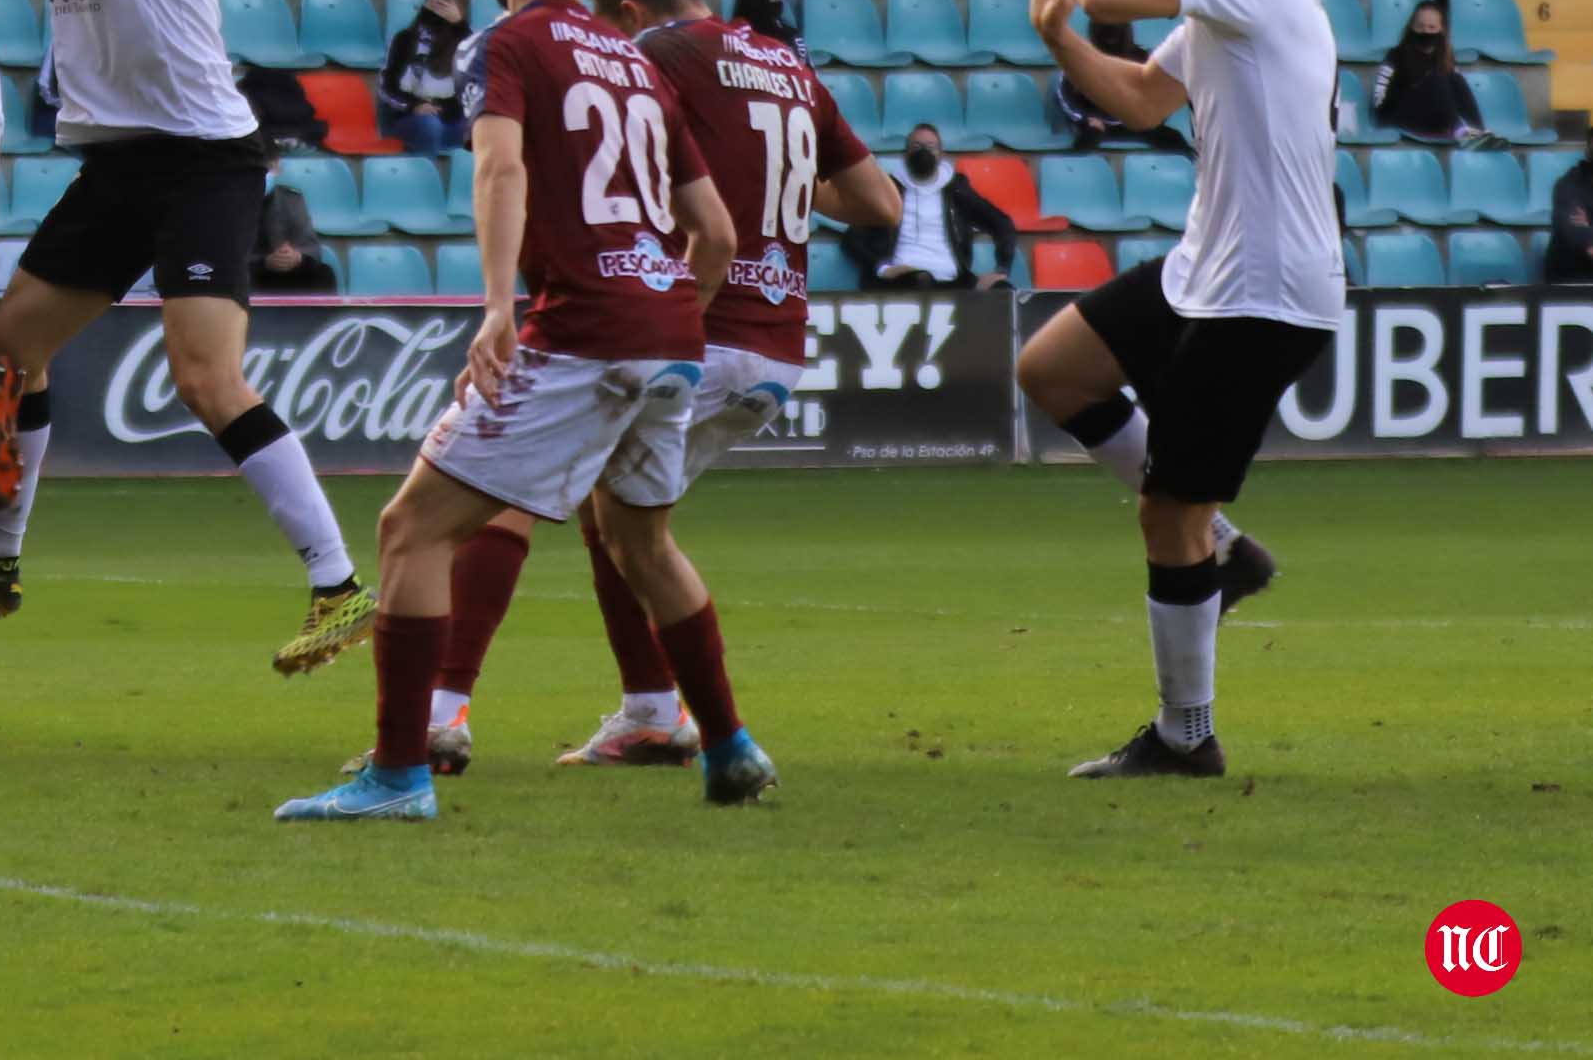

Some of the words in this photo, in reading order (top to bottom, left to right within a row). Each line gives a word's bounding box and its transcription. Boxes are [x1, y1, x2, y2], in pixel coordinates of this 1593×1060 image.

[1538, 2, 1551, 22] 6
[716, 59, 794, 100] CHARLES
[563, 81, 675, 235] 20
[748, 100, 817, 245] 18
[880, 445, 898, 458] de
[902, 445, 914, 458] la
[919, 444, 975, 458] Estación
